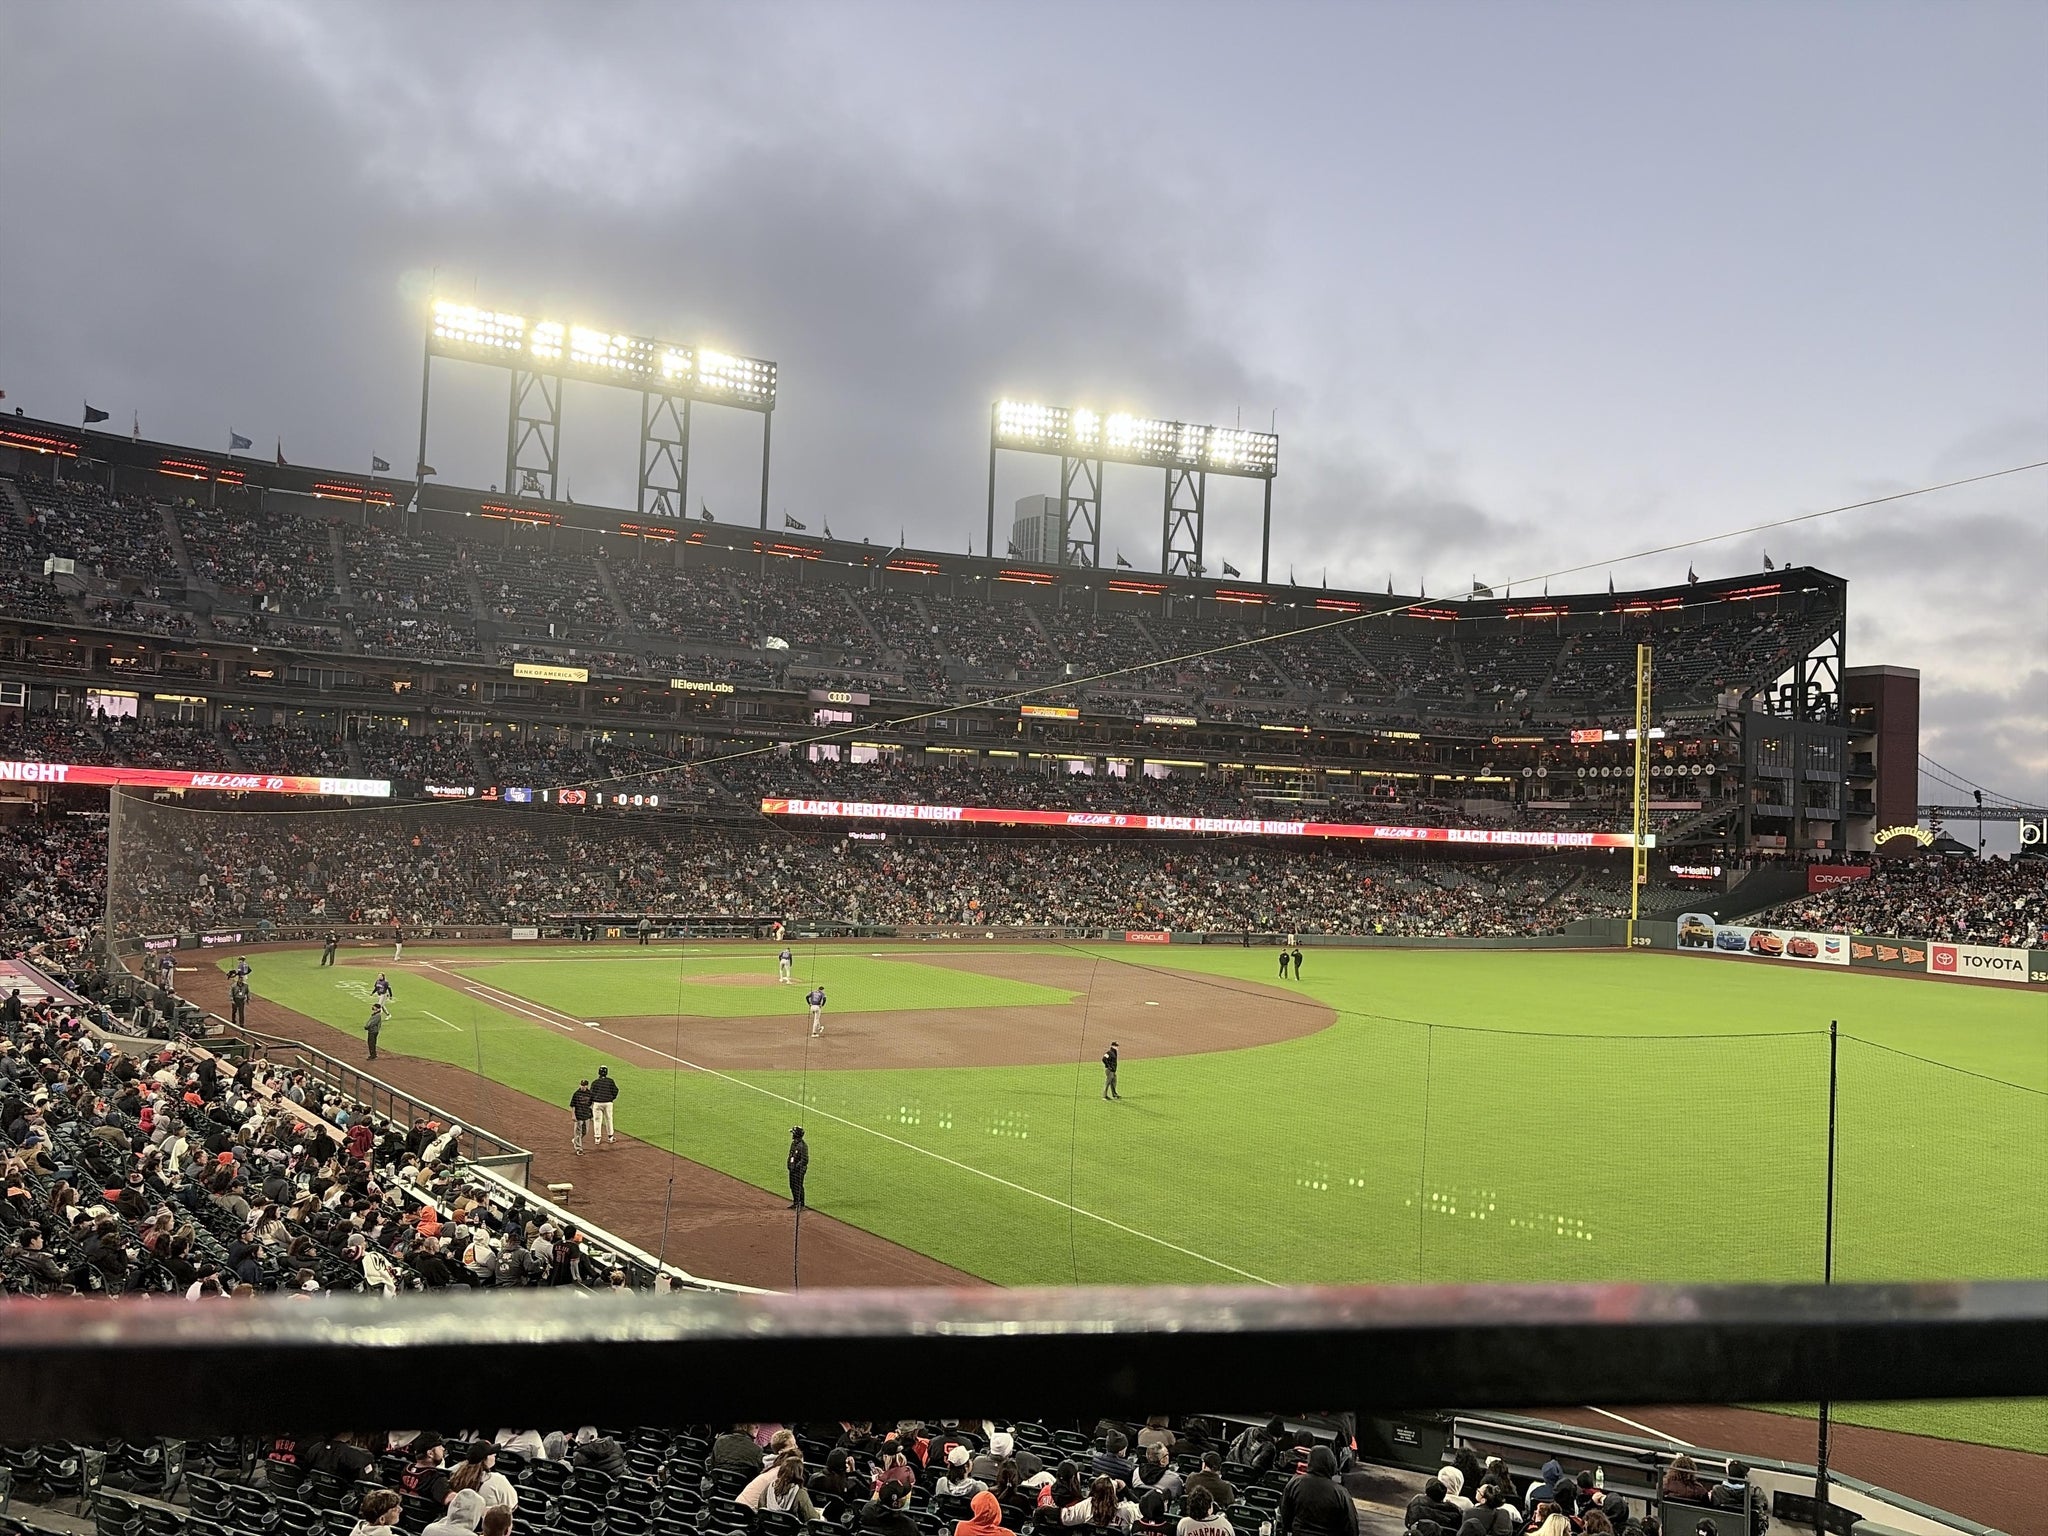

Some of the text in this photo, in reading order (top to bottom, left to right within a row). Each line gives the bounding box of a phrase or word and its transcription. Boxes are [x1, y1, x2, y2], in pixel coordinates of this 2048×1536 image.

[0, 762, 68, 782] NIGHT
[191, 774, 261, 788] WELCOME
[266, 779, 284, 789] TO
[490, 786, 496, 796] 5
[542, 790, 548, 802] 1
[596, 792, 602, 804] 1
[619, 794, 628, 805] 0
[634, 794, 642, 806] 0
[650, 795, 659, 806] 0
[788, 800, 962, 820] BLACK HERITAGE NIGHT
[1066, 814, 1305, 834] WELCOME TO BLACK HERITAGE NIGHT
[1374, 828, 1593, 845] WELCOME TO BLACK HERITAGE NIGHT
[1873, 824, 1934, 847] Ghirardelli
[1685, 866, 1710, 875] Health
[1632, 937, 1651, 945] 339
[1963, 956, 2023, 971] TOYOTA
